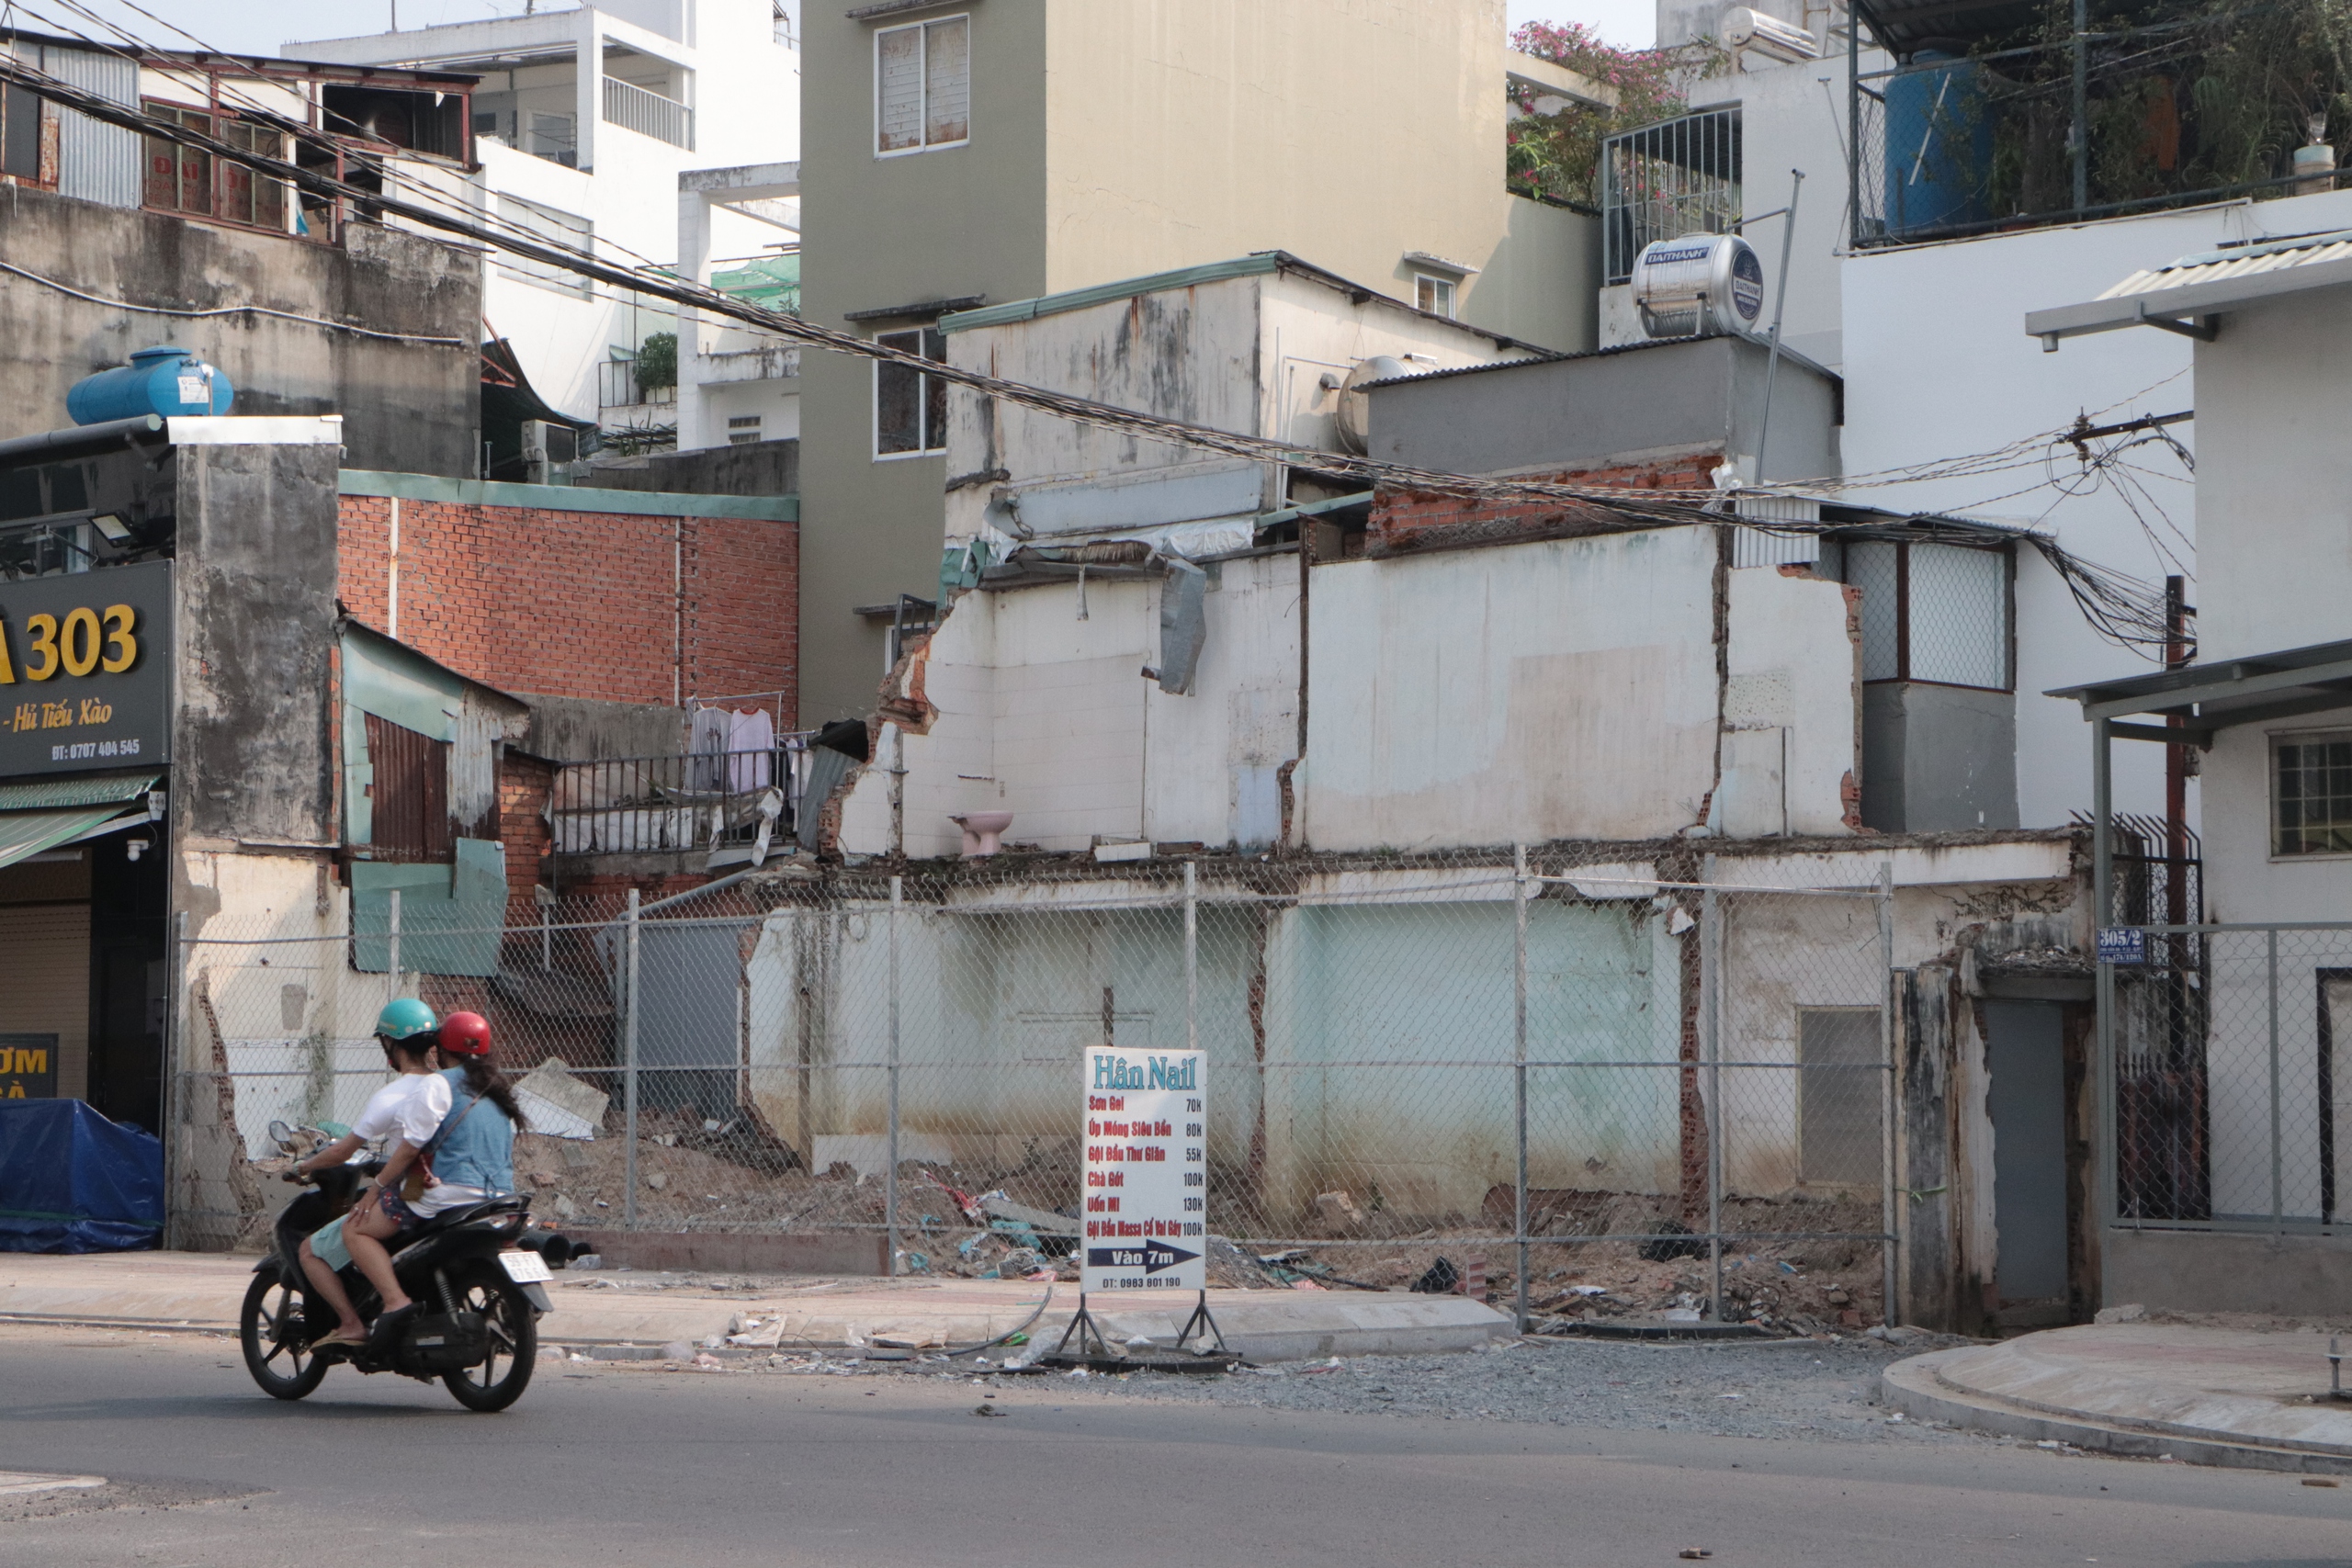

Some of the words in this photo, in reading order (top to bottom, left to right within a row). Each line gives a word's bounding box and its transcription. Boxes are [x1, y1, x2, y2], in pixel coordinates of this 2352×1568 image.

[26, 604, 137, 681] 303
[13, 703, 38, 733] Hủ
[41, 698, 74, 728] Tiếu
[78, 696, 112, 725] Xào
[51, 745, 68, 761] ĐT:
[70, 742, 96, 759] 0707
[98, 740, 118, 756] 404
[119, 739, 140, 754] 545
[2100, 930, 2141, 947] 305/2
[1093, 1055, 1145, 1090] Hân
[1148, 1055, 1197, 1091] Nail
[1089, 1095, 1107, 1111] Sơn
[1109, 1095, 1125, 1111] Gel
[1186, 1099, 1202, 1112] 70k
[1089, 1117, 1101, 1137] Úp
[1103, 1120, 1129, 1138] Móng
[1131, 1121, 1152, 1136] Siêu
[1154, 1118, 1171, 1136] Bền
[1186, 1122, 1202, 1137] 80k
[1088, 1145, 1103, 1165] Gội
[1106, 1144, 1124, 1161] Đầu
[1126, 1146, 1143, 1161] Thư
[1145, 1146, 1165, 1161] Giãn
[1186, 1147, 1202, 1162] 55k
[1088, 1171, 1106, 1187] Chà
[1108, 1171, 1124, 1187] Gót
[1183, 1172, 1203, 1187] 100k
[1087, 1194, 1105, 1213] Uốn
[1183, 1197, 1203, 1212] 130k
[1117, 1221, 1142, 1237] Massa
[1155, 1220, 1166, 1236] Vai
[1168, 1219, 1182, 1238] Gáy
[1182, 1222, 1203, 1236] 100k
[1112, 1250, 1143, 1265] Vào
[1148, 1250, 1174, 1264] 7m
[1102, 1279, 1117, 1288] ĐT:
[1120, 1278, 1144, 1288] 0983
[1147, 1278, 1162, 1288] 801
[1165, 1277, 1181, 1287] 190
